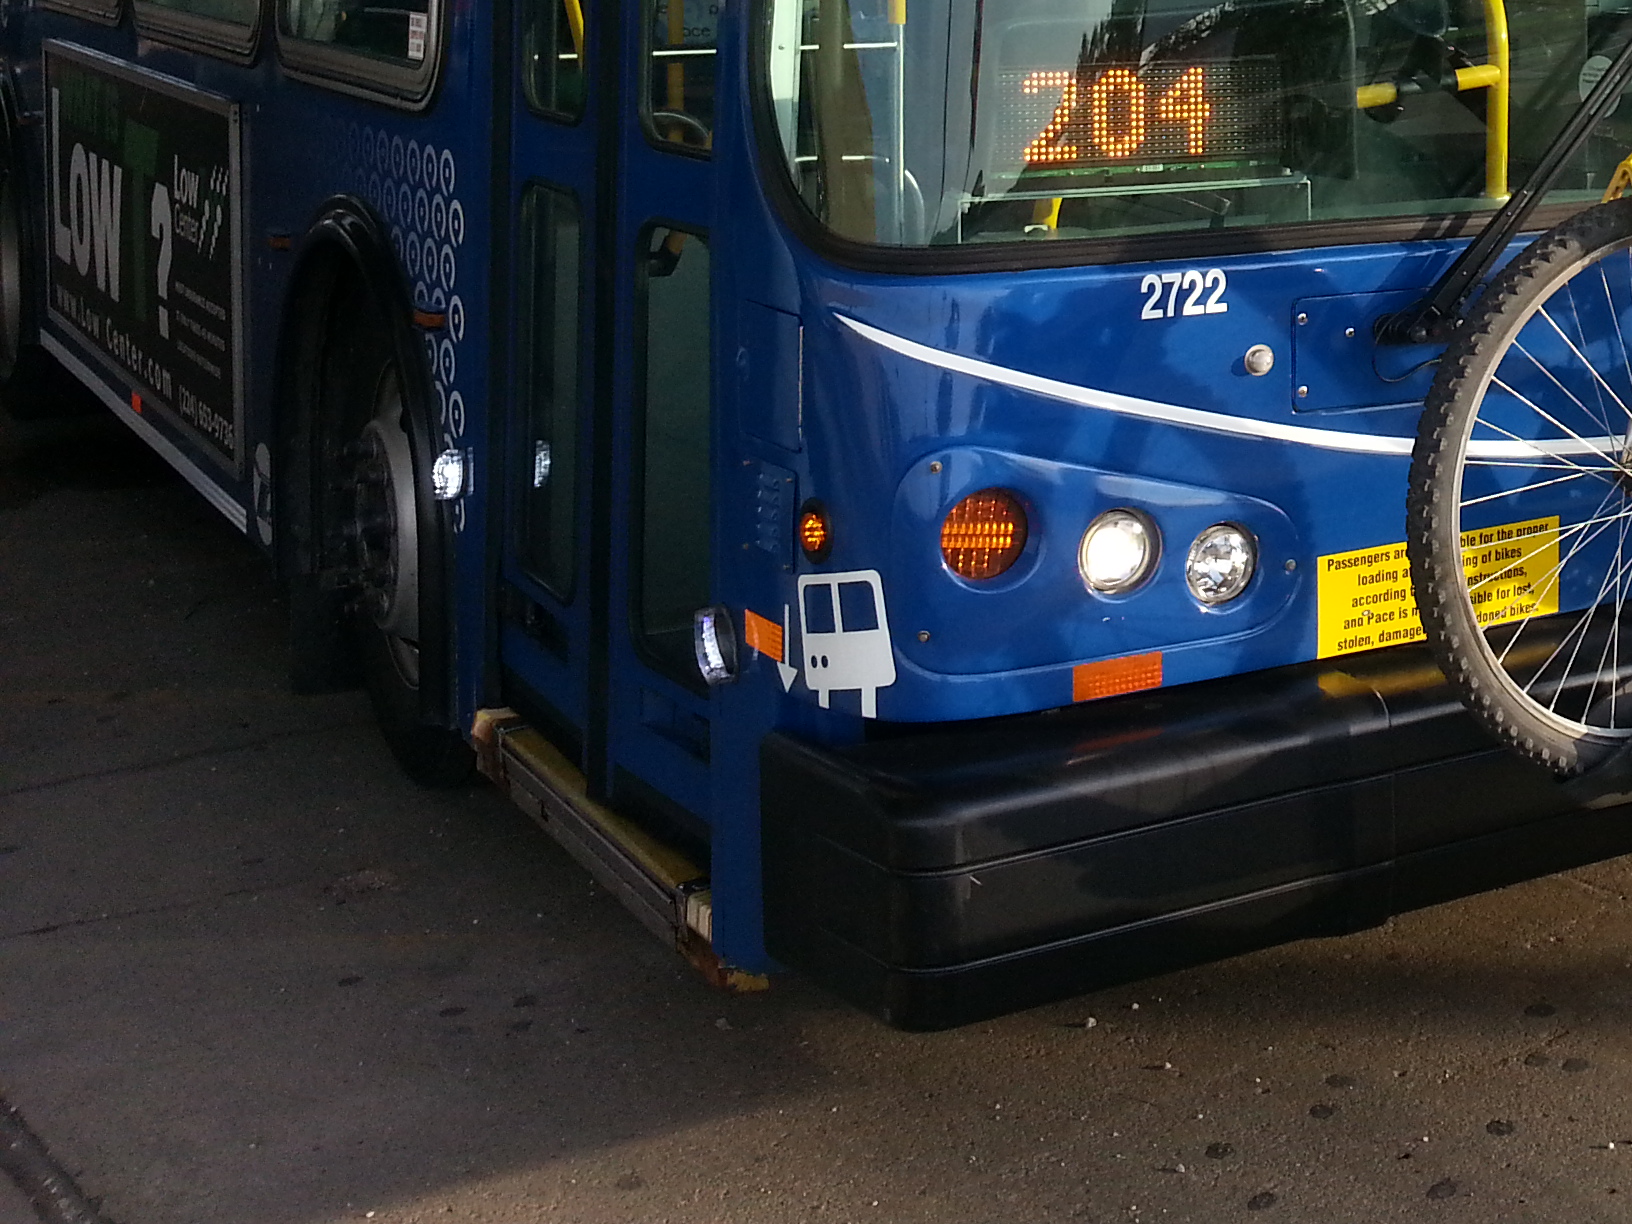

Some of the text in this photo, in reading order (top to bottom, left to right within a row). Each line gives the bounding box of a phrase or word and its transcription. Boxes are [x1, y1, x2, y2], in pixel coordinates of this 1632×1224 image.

[1023, 66, 1211, 162] 204
[51, 87, 123, 303] LOW
[173, 154, 199, 202] Low
[1141, 268, 1228, 320] 2722
[1328, 551, 1390, 572] Passengers
[1394, 549, 1408, 560] ar
[1479, 532, 1494, 545] for
[1497, 529, 1513, 542] the
[1358, 569, 1399, 586] loading
[1482, 550, 1492, 564] of
[1495, 547, 1522, 561] bikes
[1352, 587, 1407, 608] according
[1467, 566, 1527, 587] nstructions,
[1367, 611, 1395, 626] Pace
[1399, 606, 1409, 620] is
[1497, 587, 1511, 600] for
[1337, 635, 1375, 652] stolen,
[1378, 625, 1423, 642] damage
